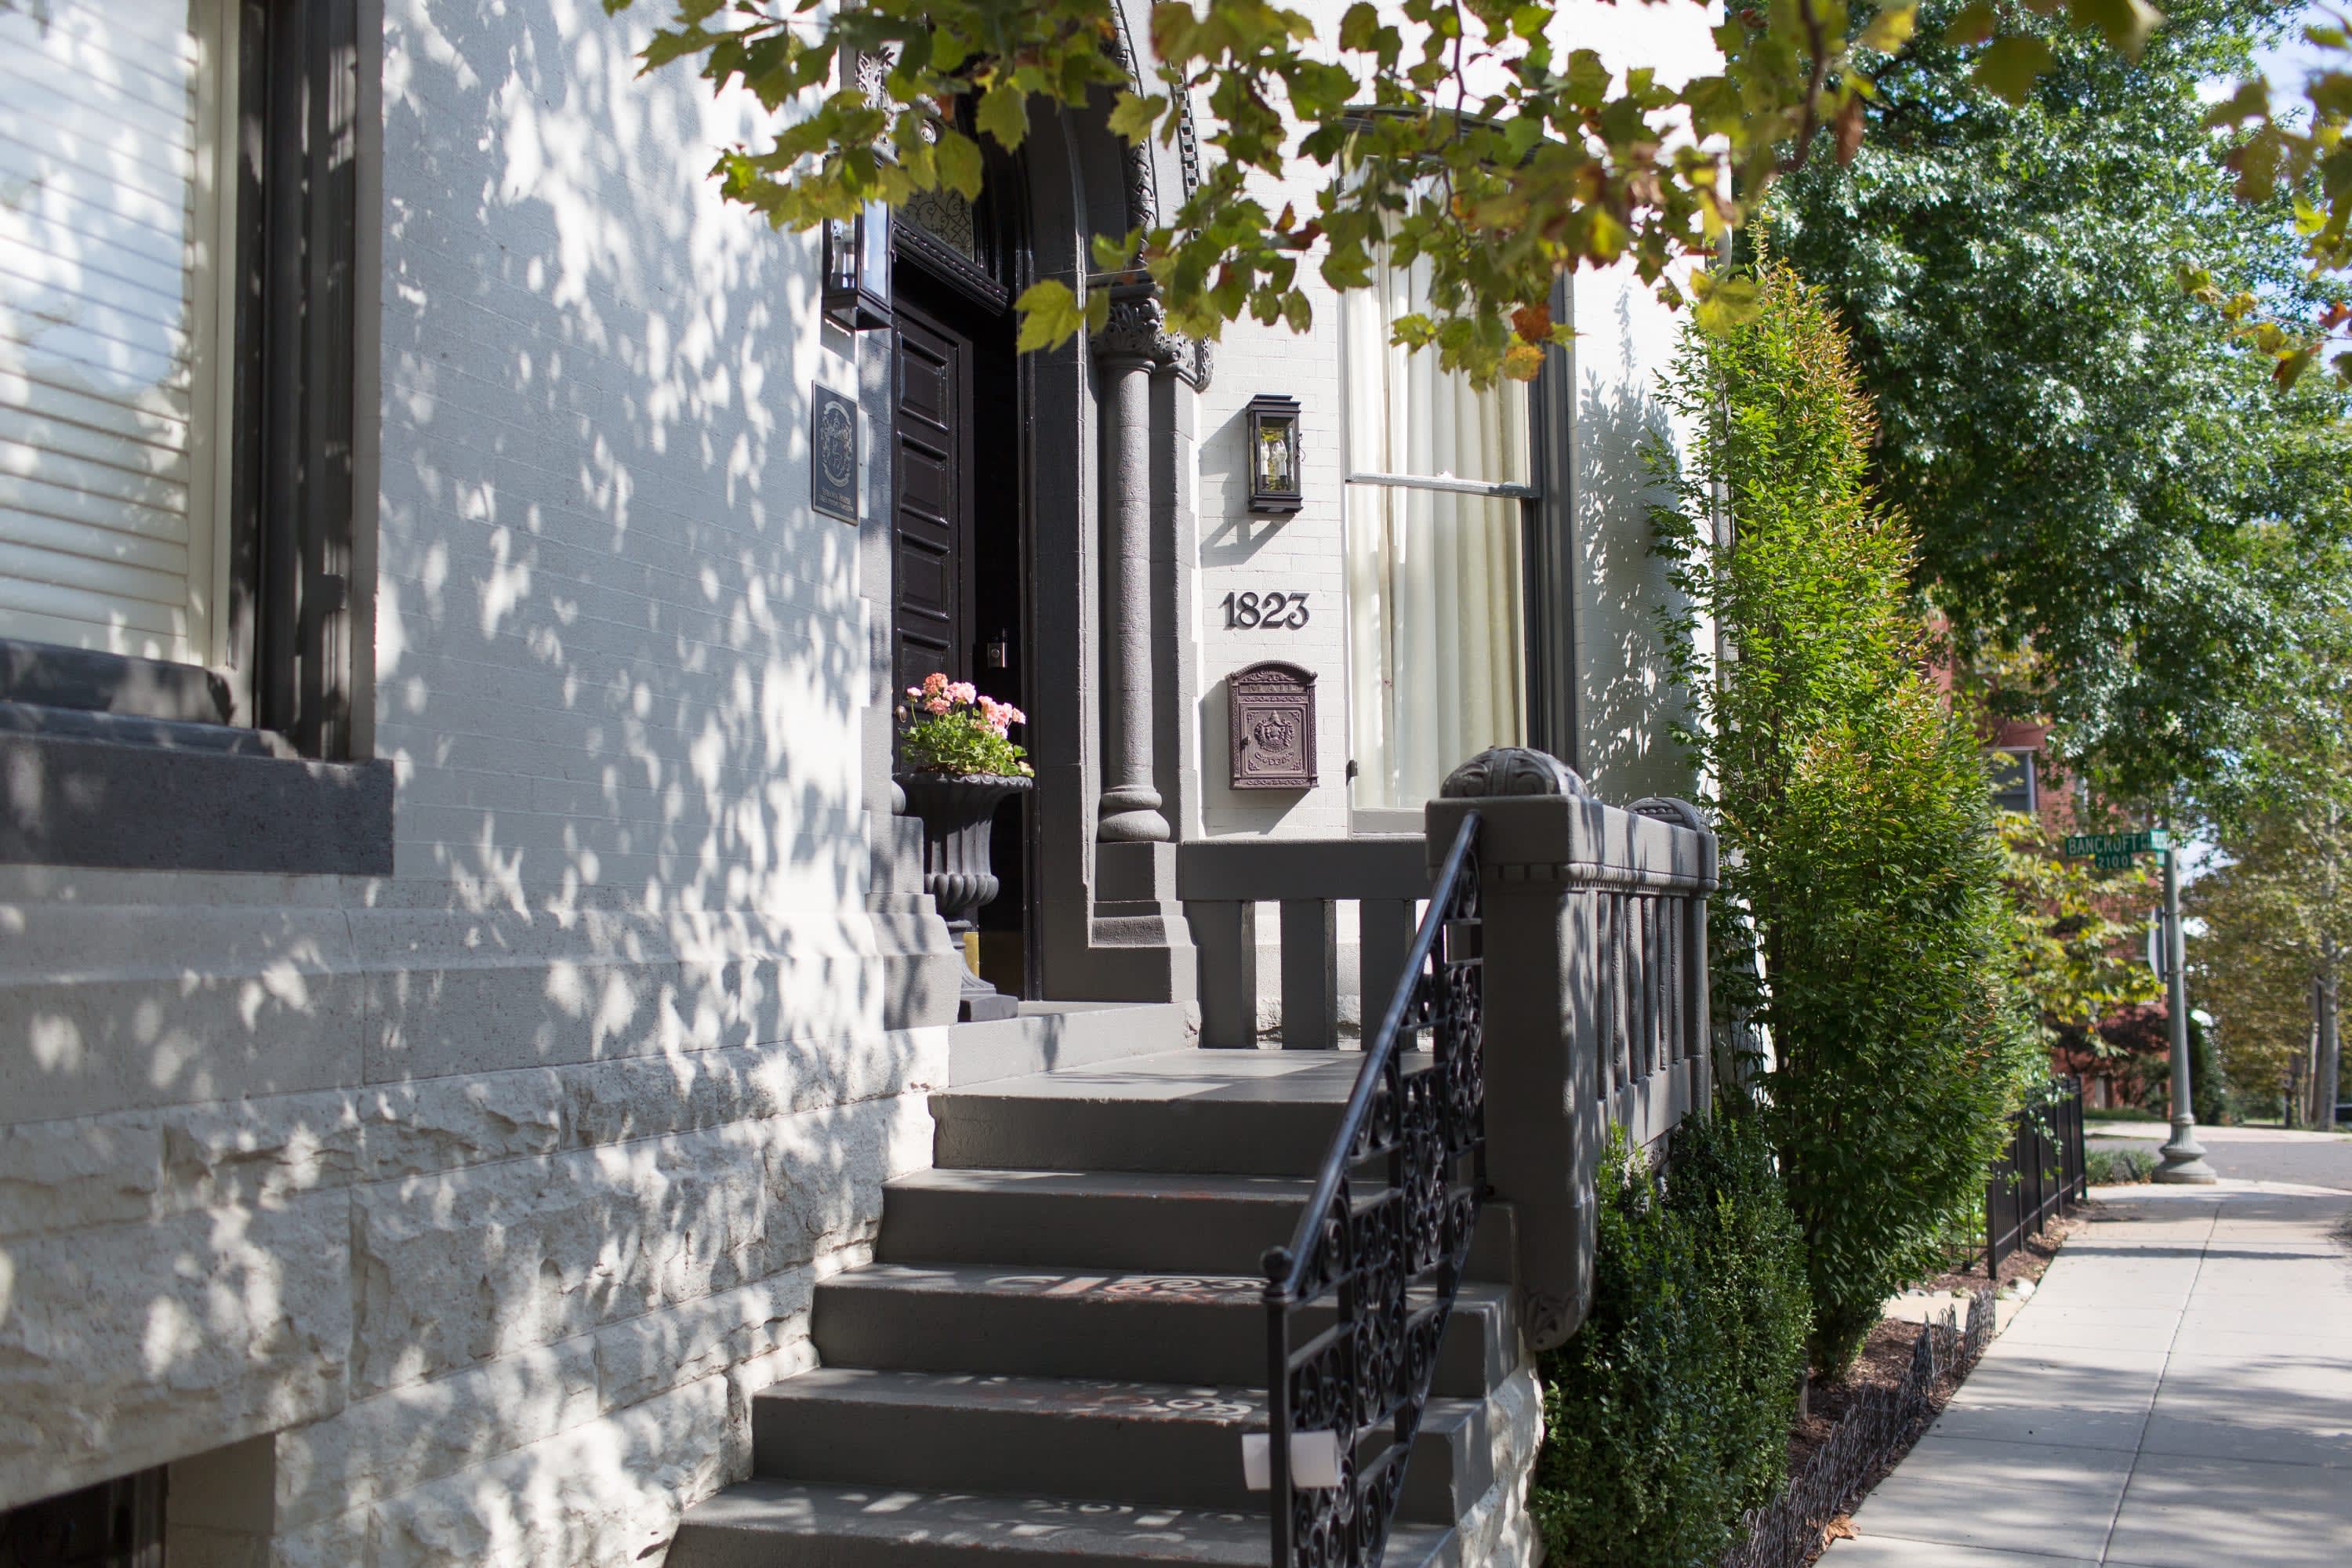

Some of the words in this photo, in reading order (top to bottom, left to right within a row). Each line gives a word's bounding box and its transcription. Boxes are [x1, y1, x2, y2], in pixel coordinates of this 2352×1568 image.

[1221, 591, 1310, 629] 1823
[2068, 834, 2137, 855] BANCROFT
[2098, 855, 2129, 868] 2100
